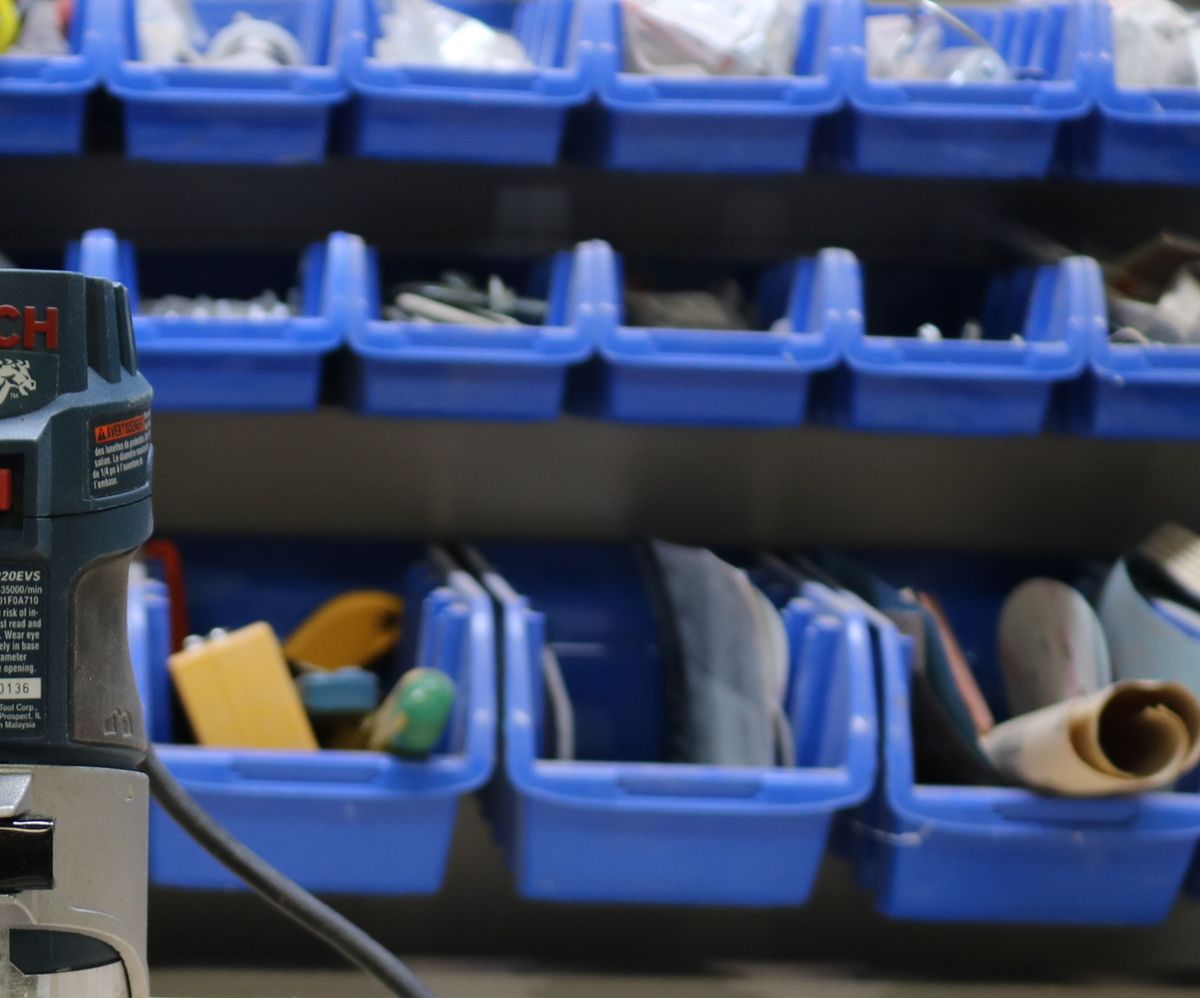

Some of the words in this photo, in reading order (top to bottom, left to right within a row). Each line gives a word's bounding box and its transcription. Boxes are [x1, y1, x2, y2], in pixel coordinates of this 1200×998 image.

[3, 607, 18, 617] risk
[19, 607, 27, 617] of
[28, 607, 39, 617] in-
[8, 619, 26, 628] read
[27, 618, 42, 628] and
[3, 630, 25, 639] Wear
[26, 631, 40, 641] eye
[12, 642, 20, 650] in
[21, 641, 40, 650] base
[3, 663, 37, 674] opening.
[0, 703, 14, 711] Tool
[4, 721, 36, 729] Malaysia
